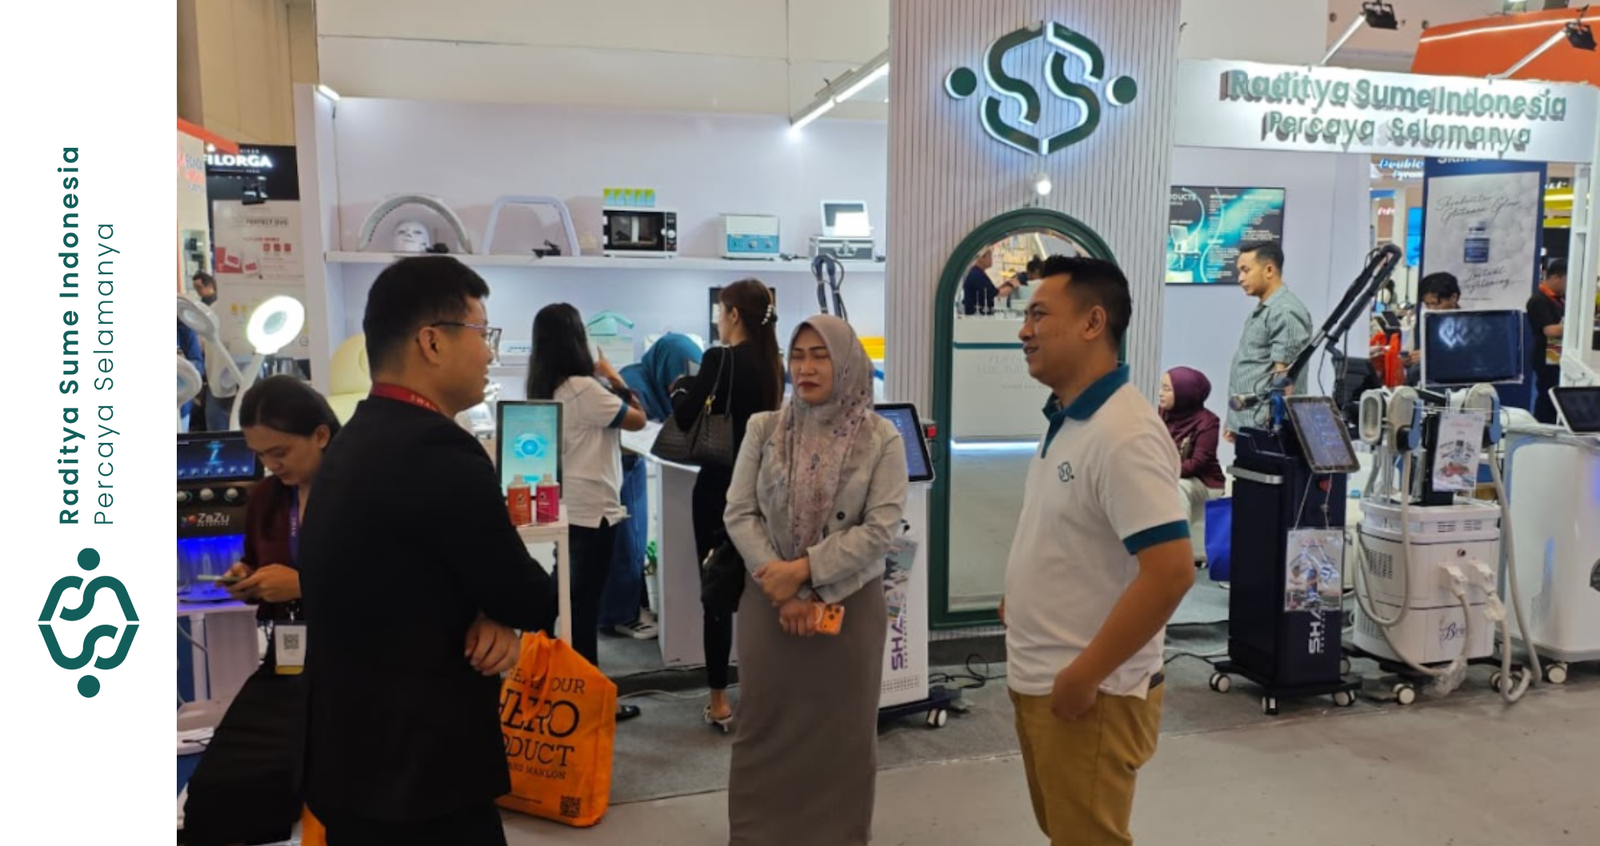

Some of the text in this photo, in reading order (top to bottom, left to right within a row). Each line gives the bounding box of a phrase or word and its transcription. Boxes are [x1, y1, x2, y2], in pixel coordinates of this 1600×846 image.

[1222, 69, 1567, 119] Raditya Sume Indonesia
[1264, 110, 1531, 155] Percaya Selamanya
[550, 677, 586, 694] OUR
